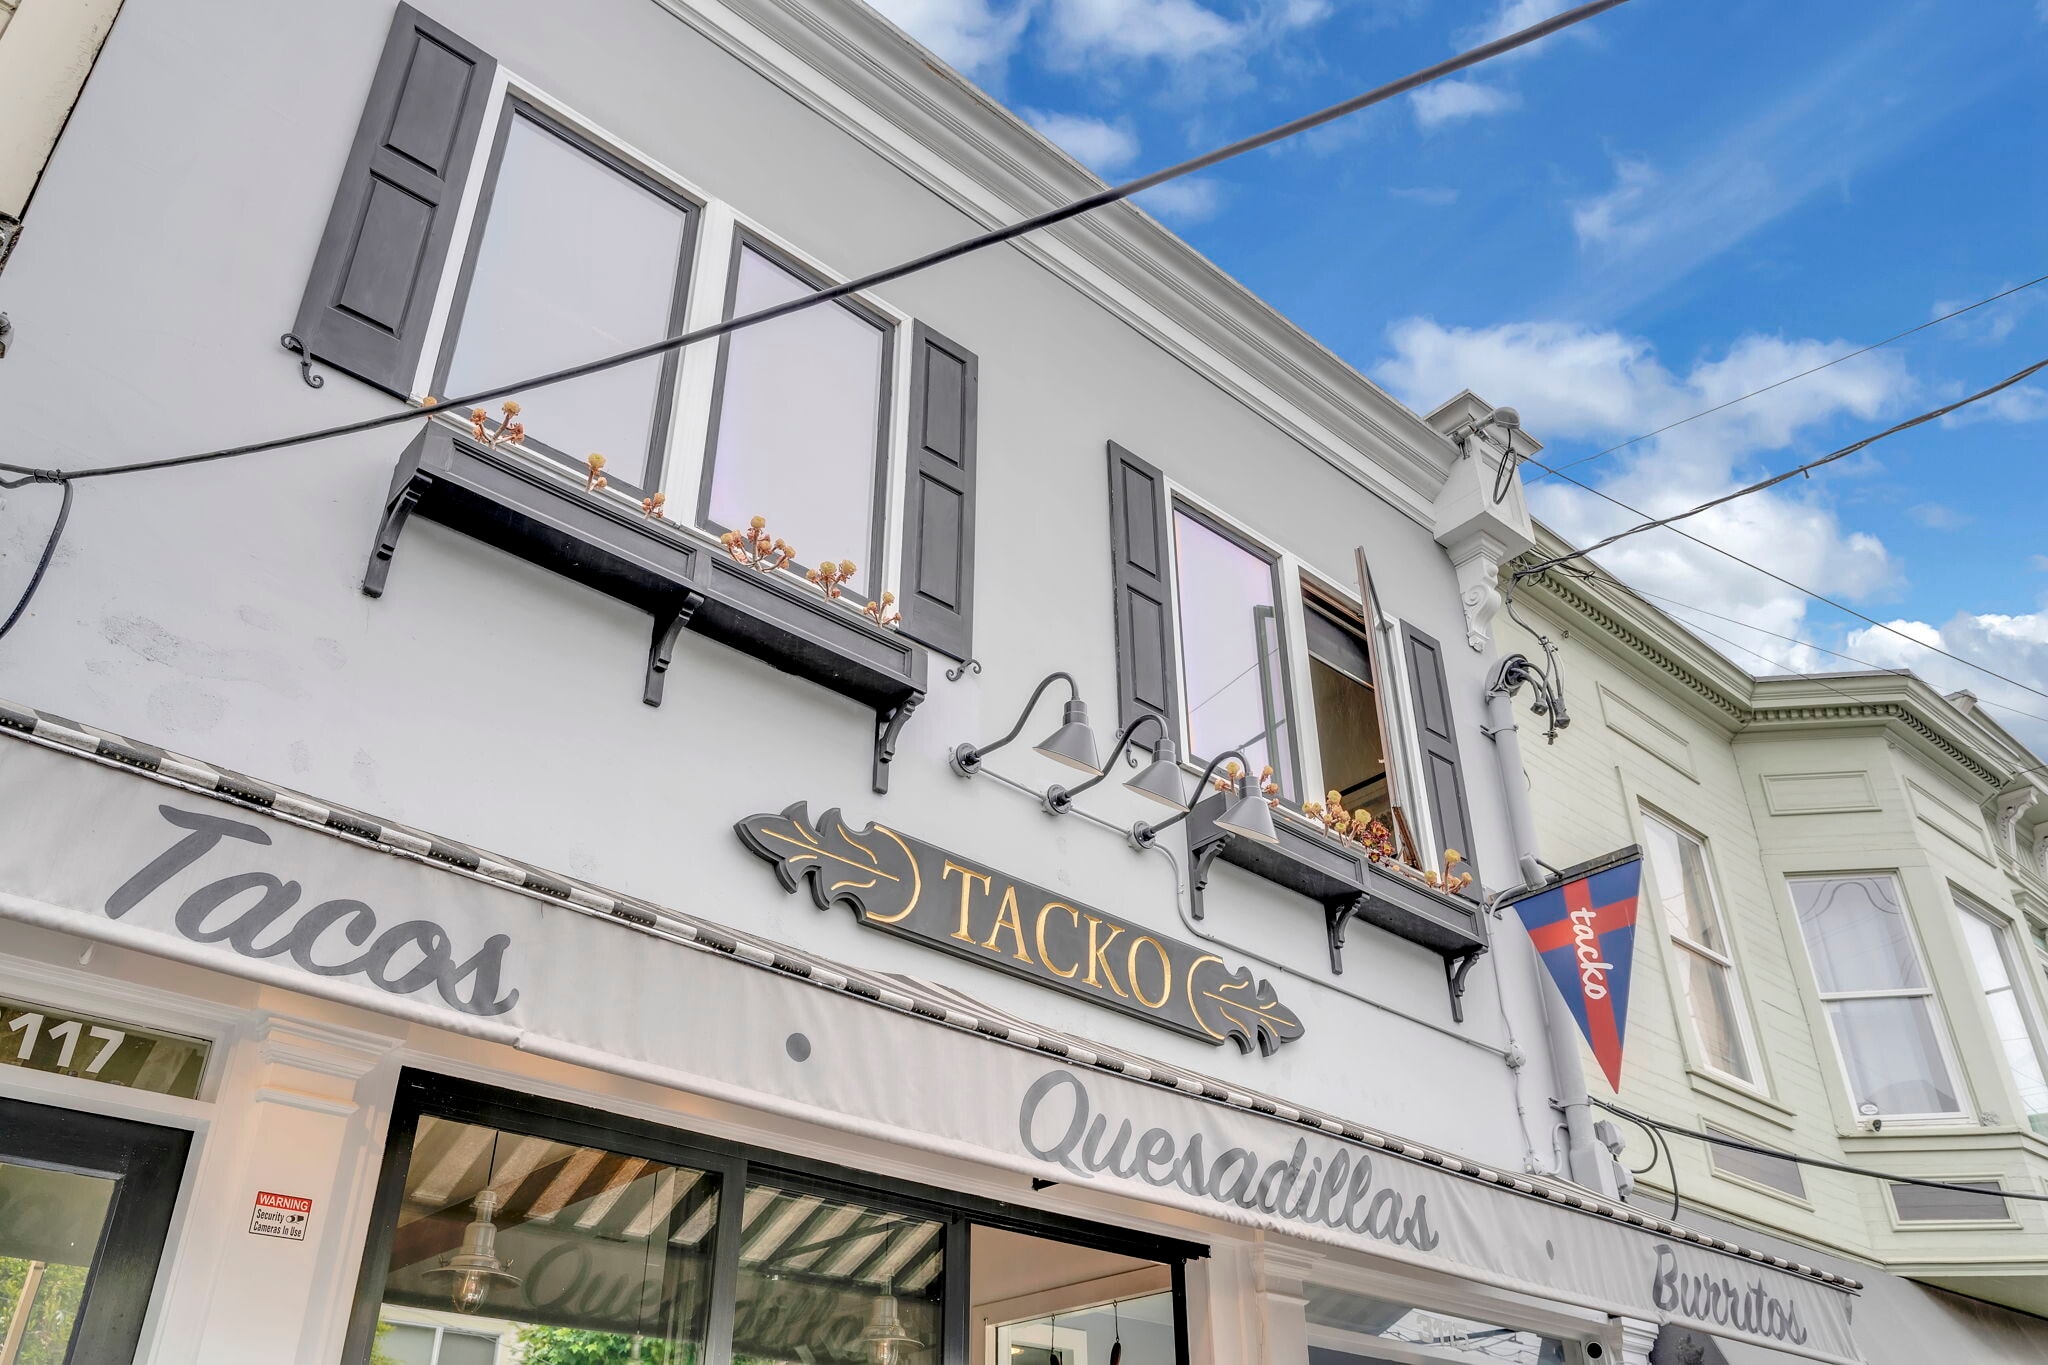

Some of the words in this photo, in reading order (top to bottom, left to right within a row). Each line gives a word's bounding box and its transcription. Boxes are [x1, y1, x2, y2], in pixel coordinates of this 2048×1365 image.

[104, 804, 520, 1016] Tacos
[942, 857, 1172, 1008] TACKO
[1570, 907, 1613, 1000] tacko
[260, 1194, 308, 1210] WARNING
[1019, 1070, 1439, 1251] Quesadillas
[253, 1220, 281, 1234] Cameras
[282, 1225, 289, 1236] In
[289, 1226, 302, 1238] Use
[256, 1208, 284, 1224] Security
[1652, 1243, 1807, 1346] Burritos
